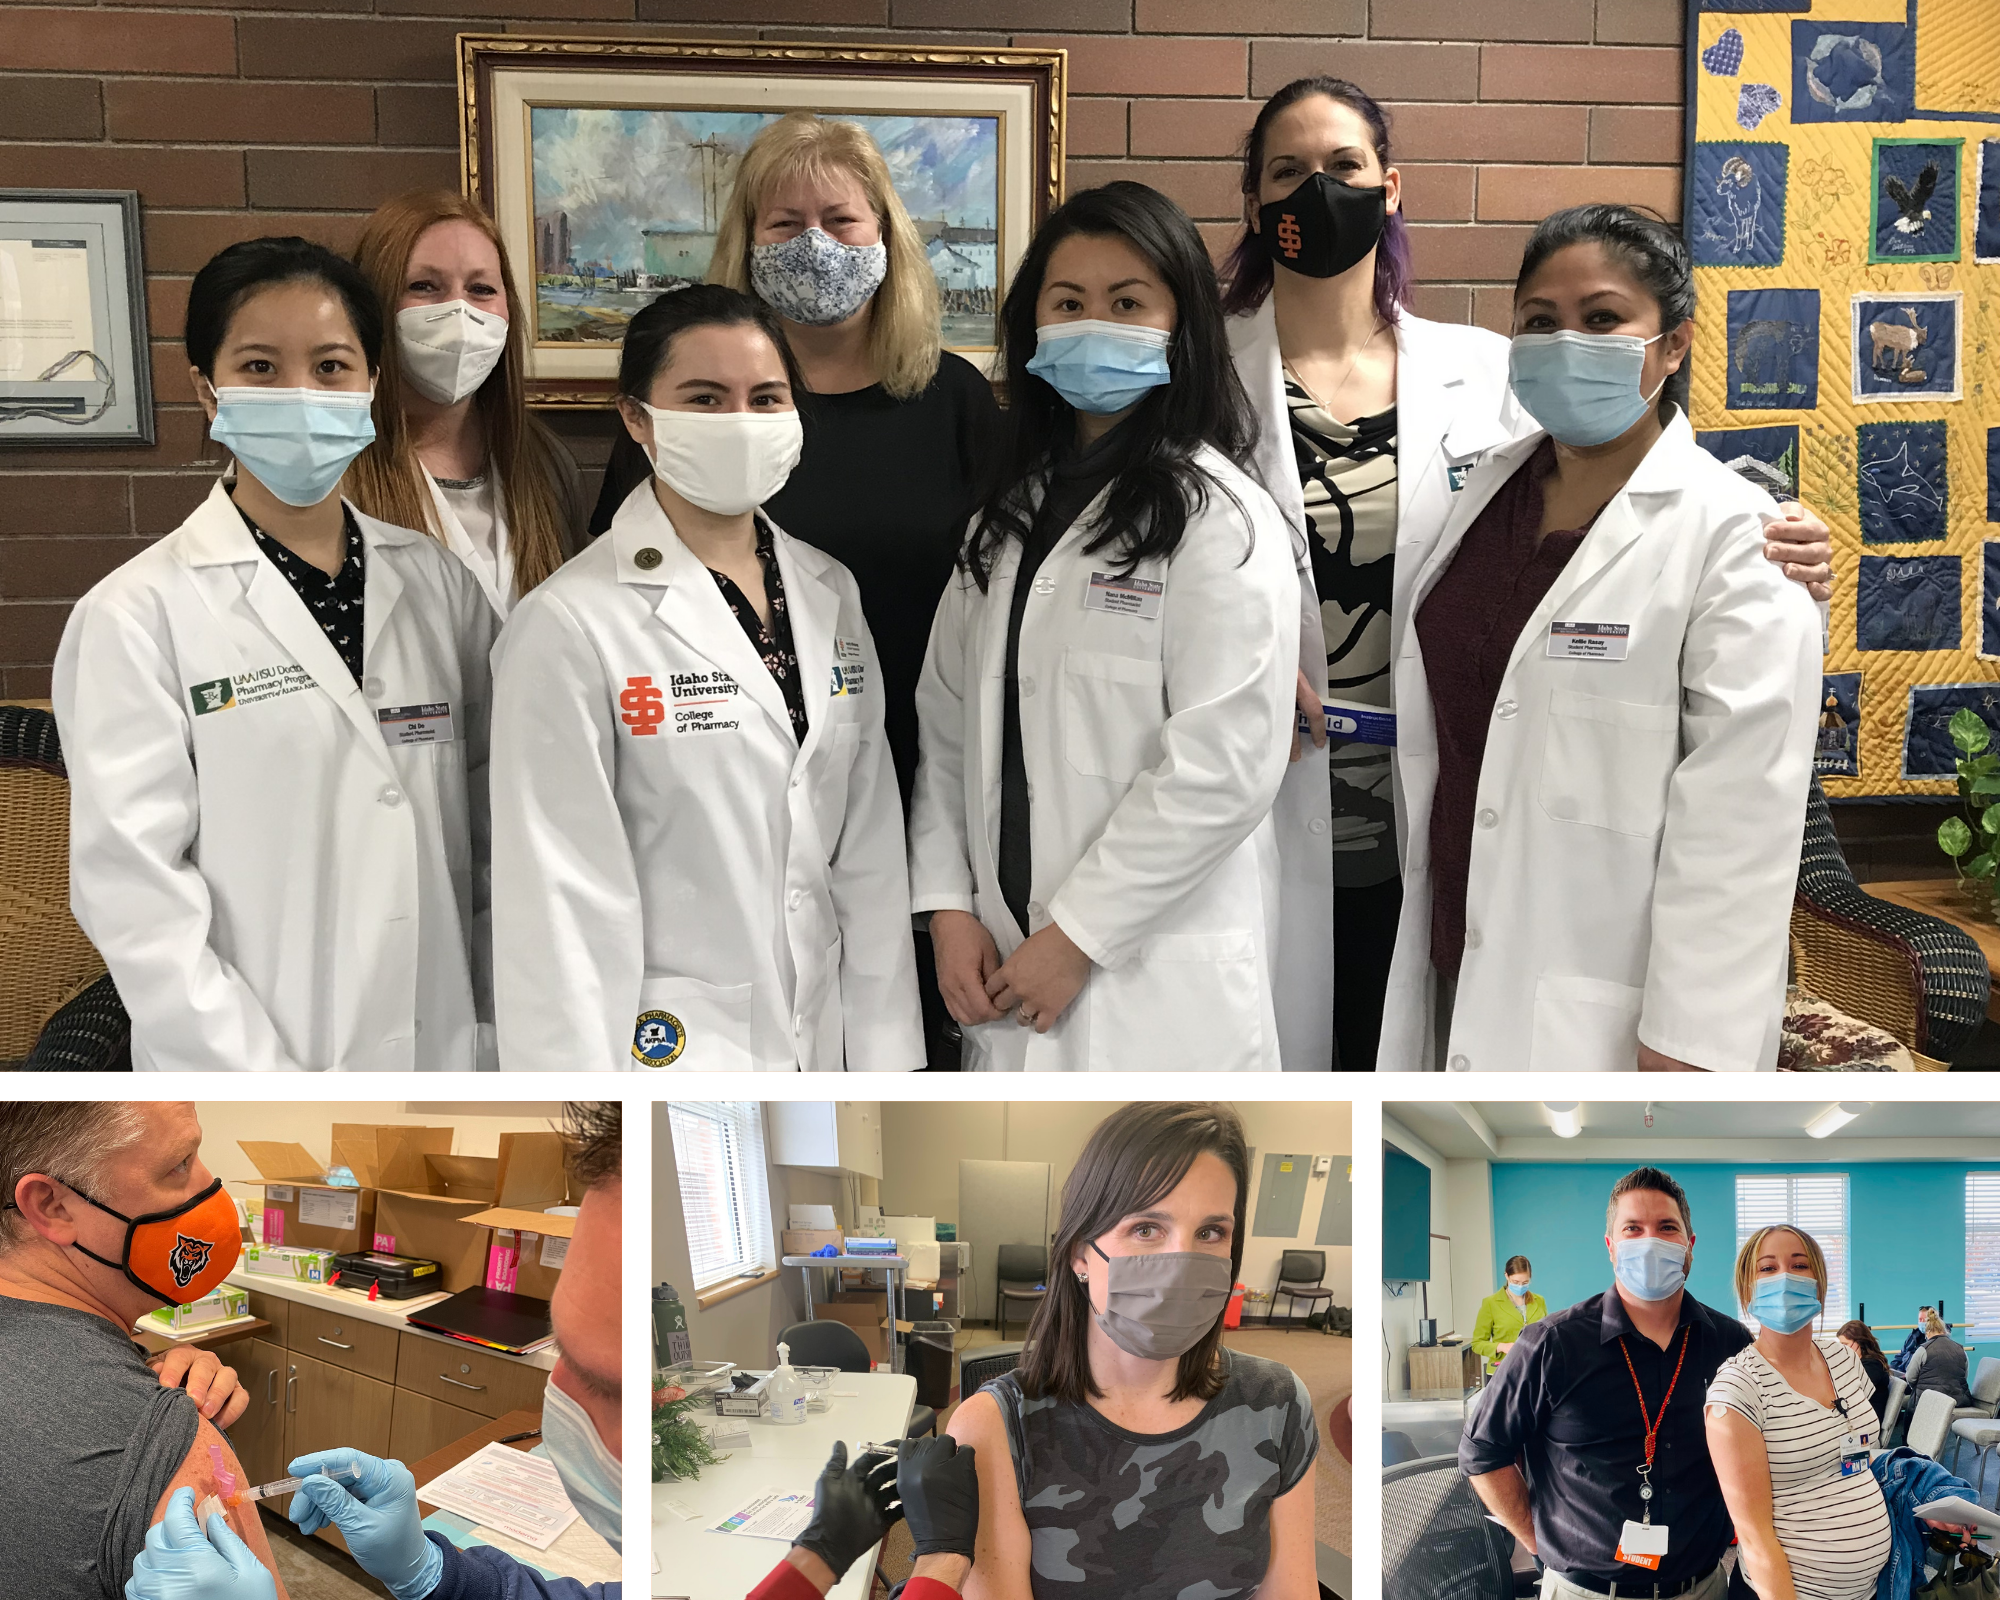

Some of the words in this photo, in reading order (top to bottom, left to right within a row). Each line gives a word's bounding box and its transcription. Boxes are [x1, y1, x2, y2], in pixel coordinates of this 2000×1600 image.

[236, 678, 283, 696] Pharmacy
[670, 673, 709, 687] Idaho
[238, 691, 275, 705] UNIVERSITY
[282, 686, 304, 695] ALASKA
[671, 683, 739, 698] University
[675, 710, 714, 722] College
[676, 722, 688, 733] of
[691, 720, 740, 732] Pharmacy
[376, 1236, 388, 1248] PA
[496, 1252, 504, 1280] PRIORITY
[312, 1270, 319, 1278] M
[504, 1524, 538, 1542] moderna
[1622, 1554, 1652, 1566] STUDENT
